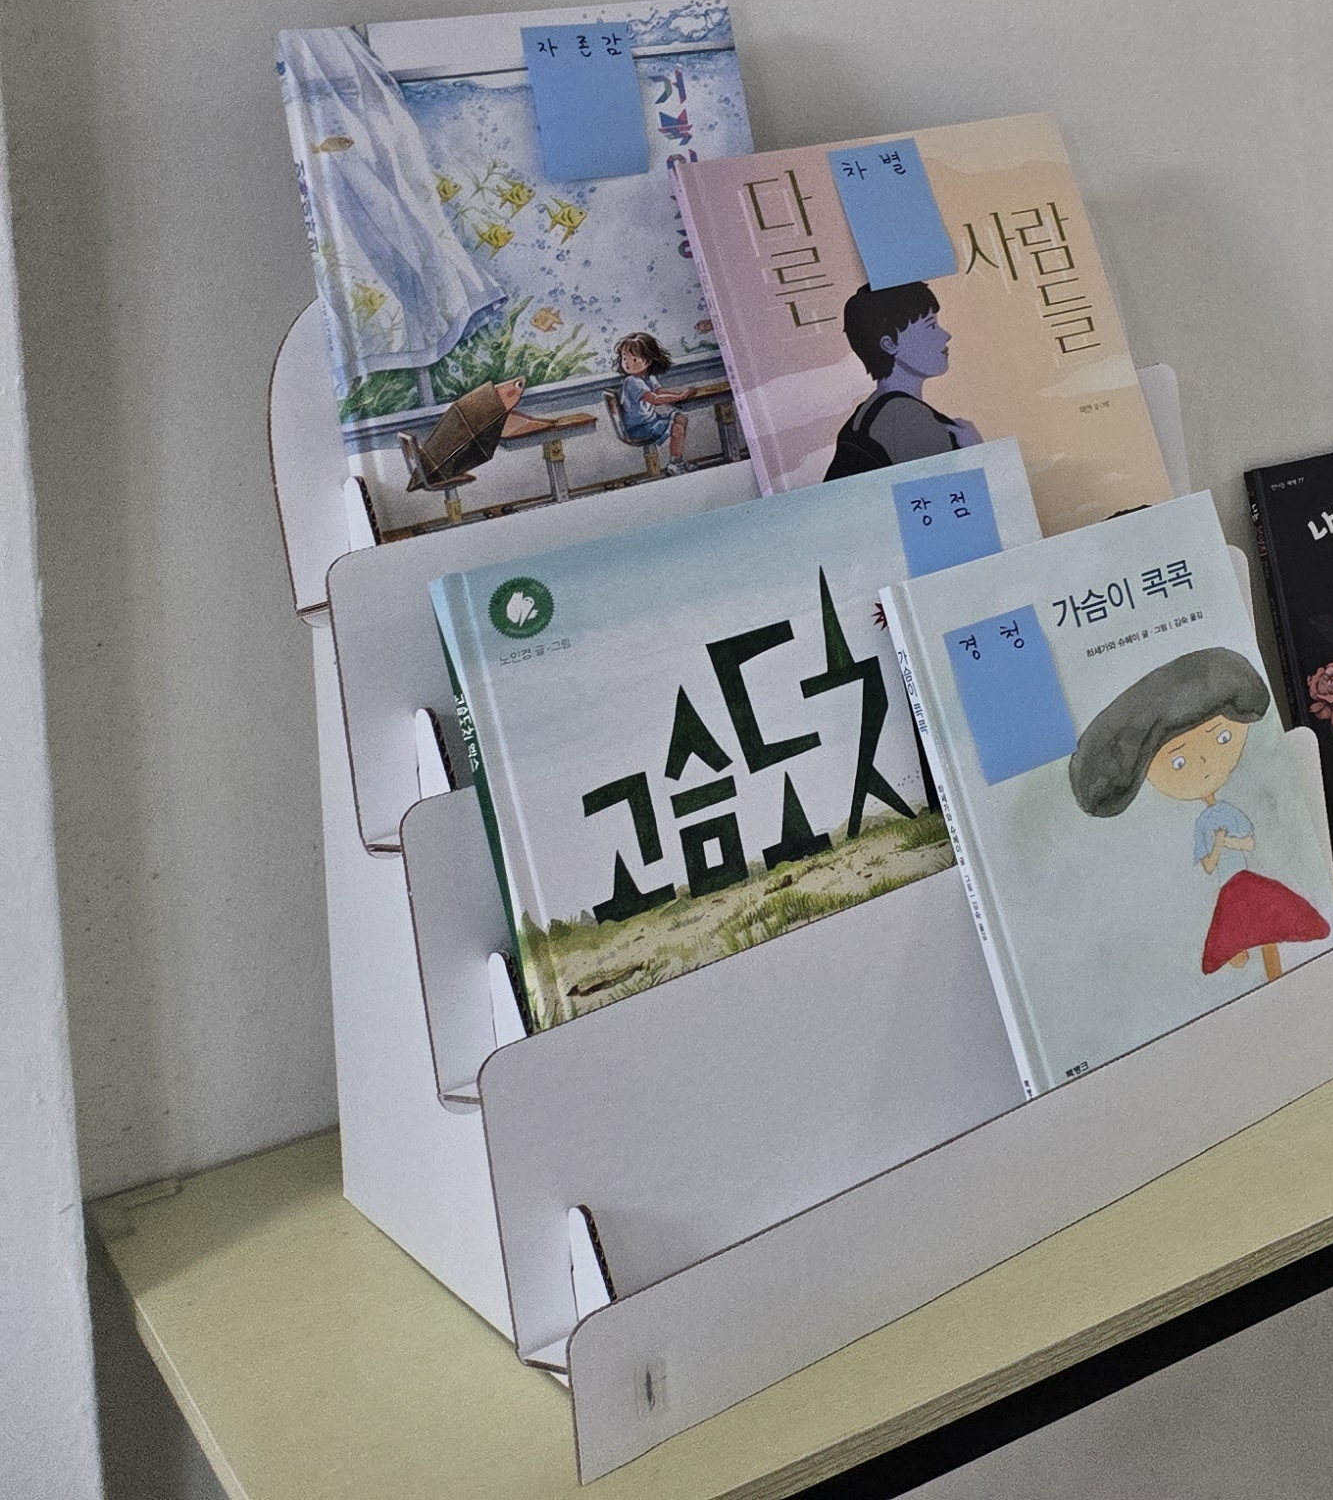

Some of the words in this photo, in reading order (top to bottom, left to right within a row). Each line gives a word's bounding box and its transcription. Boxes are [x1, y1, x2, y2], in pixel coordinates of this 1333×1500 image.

[841, 150, 908, 181] 차별
[743, 168, 838, 329] 다른
[964, 200, 1102, 355] 사람들
[910, 490, 972, 527] 장점
[1052, 577, 1136, 628] 가슴이
[1141, 559, 1194, 599] 콕콕
[454, 693, 476, 741] 고슴도치
